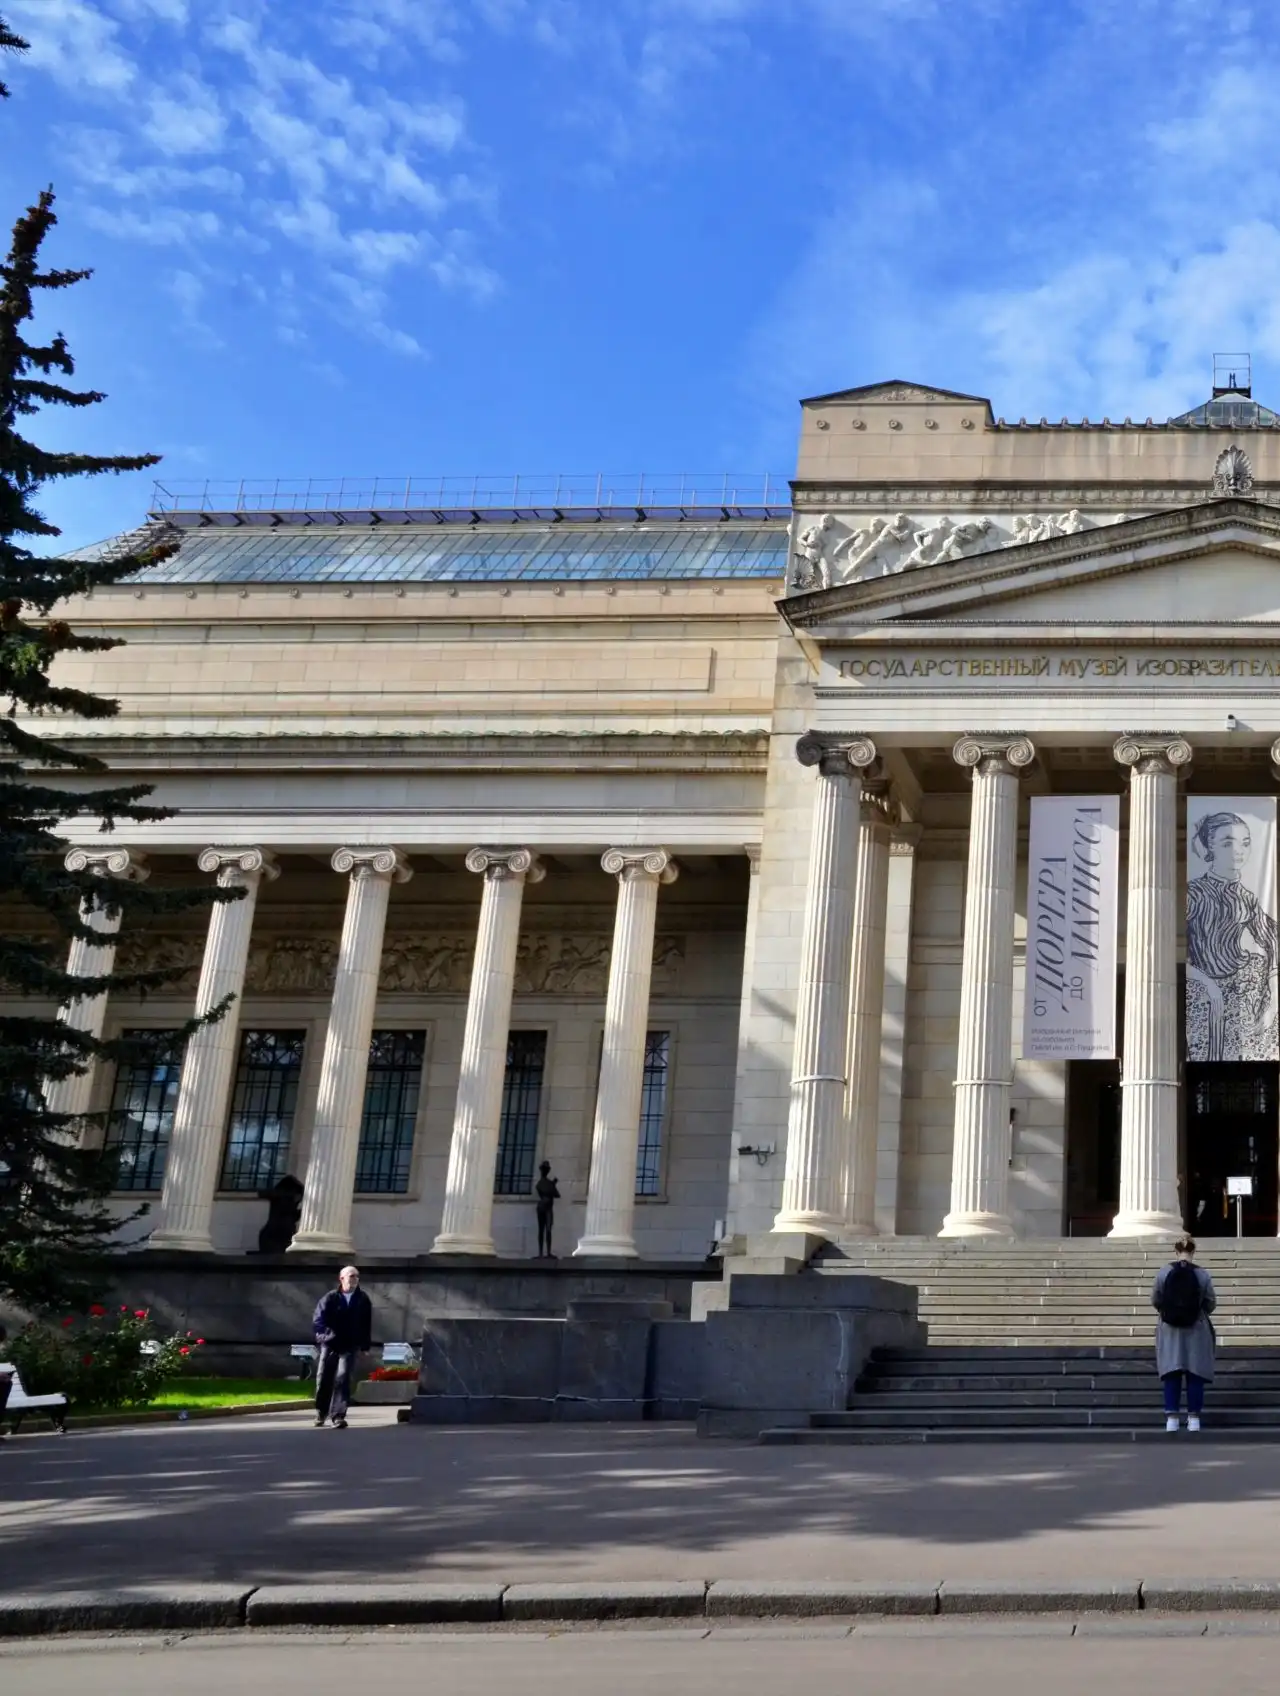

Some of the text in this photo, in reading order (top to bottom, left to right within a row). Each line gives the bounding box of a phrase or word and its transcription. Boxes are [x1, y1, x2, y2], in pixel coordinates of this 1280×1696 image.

[838, 656, 1050, 678] ГОСУДАРСТВЕННЫЙ
[1057, 656, 1128, 678] МУЗЕЙ
[1036, 855, 1070, 1013] ДЮРЕРА
[1071, 806, 1102, 977] МАТИССА
